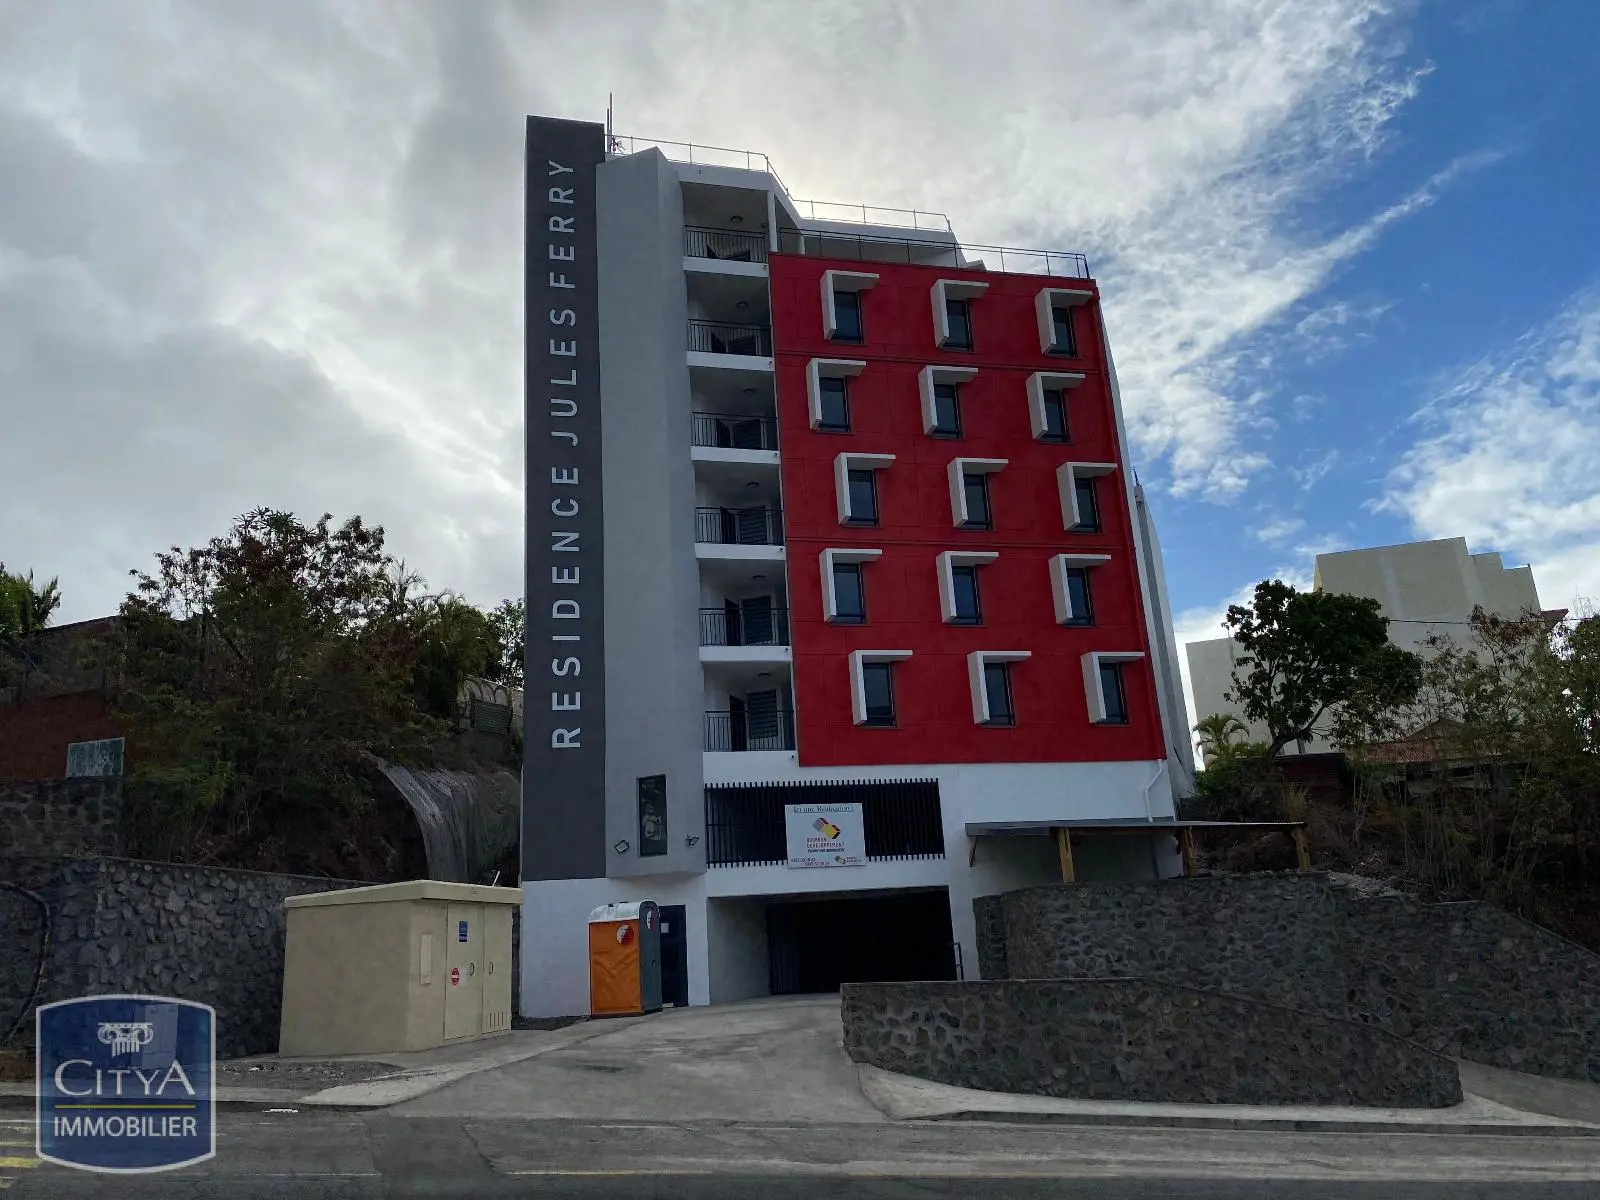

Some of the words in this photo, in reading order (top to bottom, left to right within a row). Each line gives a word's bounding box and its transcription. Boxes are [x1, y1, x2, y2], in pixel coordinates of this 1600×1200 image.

[548, 159, 575, 289] FERRY
[549, 309, 578, 447] JULES
[551, 466, 581, 748] RESIDENCE
